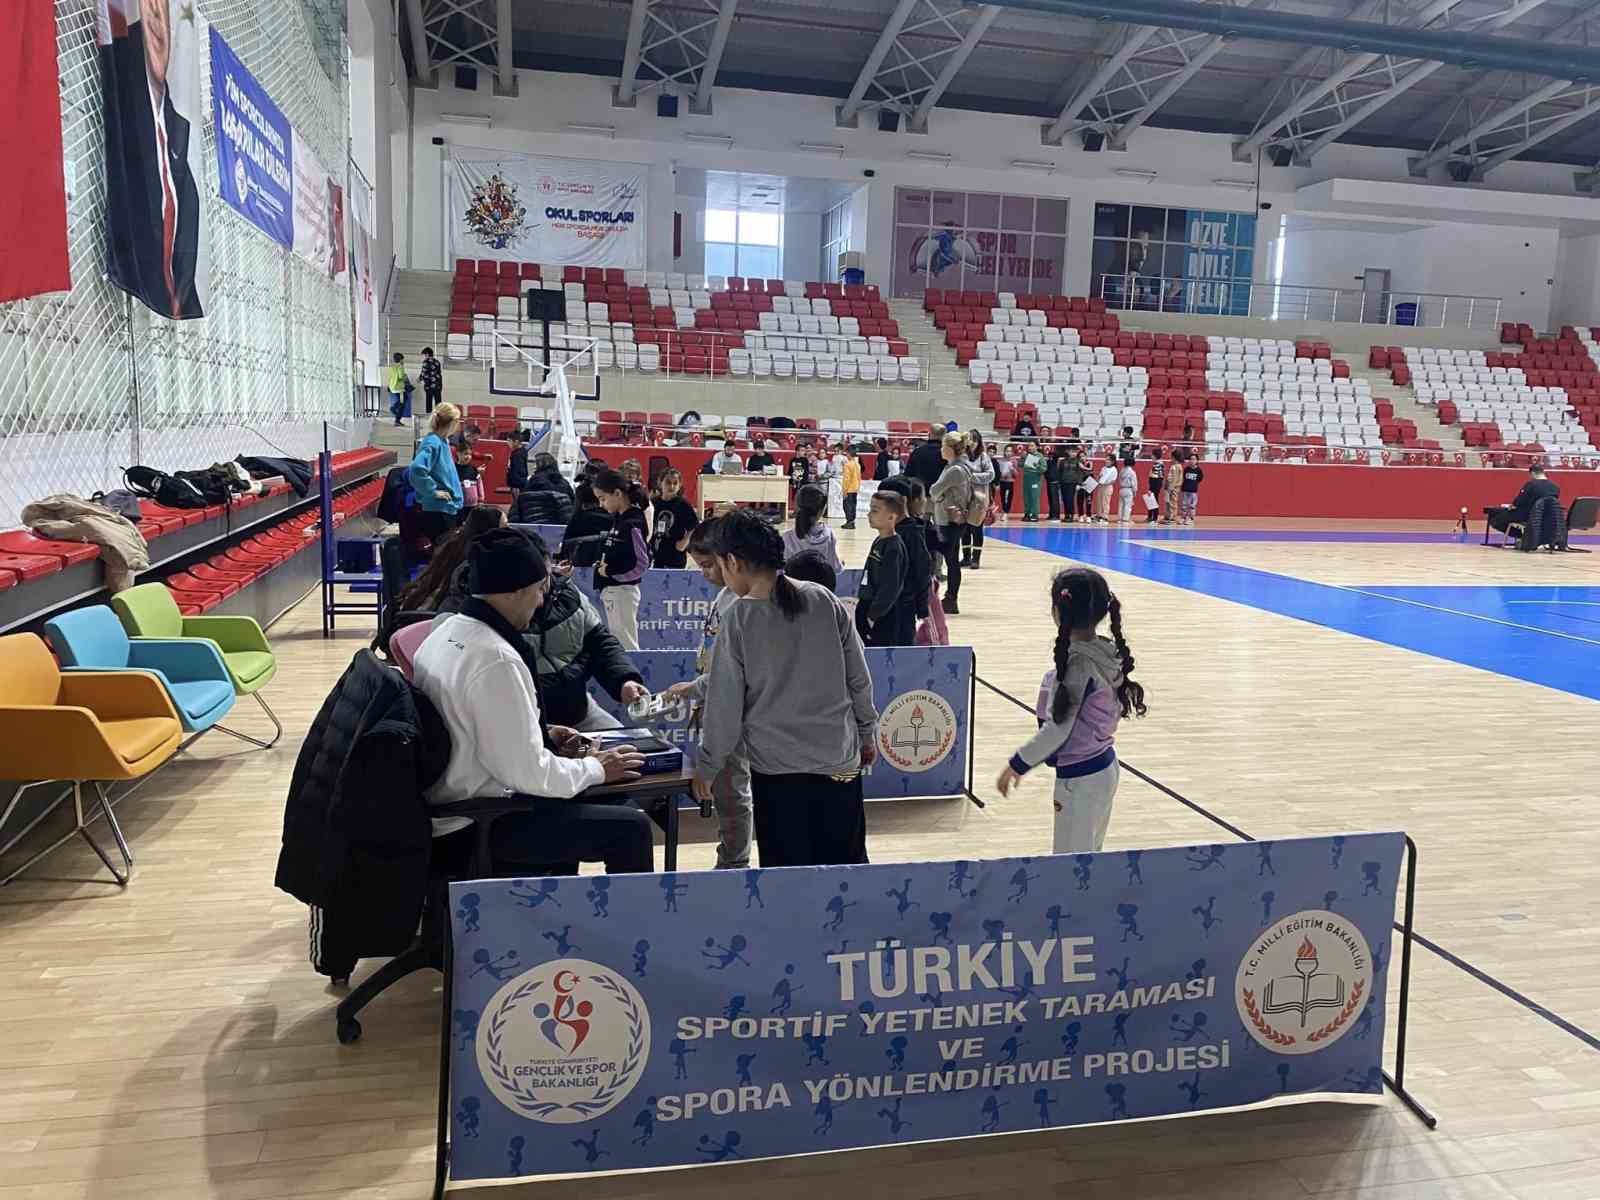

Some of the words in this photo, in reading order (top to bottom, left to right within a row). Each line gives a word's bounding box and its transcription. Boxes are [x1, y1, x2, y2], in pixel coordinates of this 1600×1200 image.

[545, 206, 577, 222] OKUL
[1256, 929, 1285, 956] MİLLİ
[1286, 919, 1323, 935] EĞİTİM
[1325, 922, 1364, 971] BAKANLIĞI
[827, 931, 1096, 1001] TÜRKİYE
[676, 1011, 849, 1040] SPORTİF
[859, 1000, 1029, 1034] YETENEK
[1040, 976, 1216, 1020] TARAMASI
[938, 1036, 985, 1061] VE
[513, 1064, 566, 1077] GENÇLİK
[567, 1063, 584, 1075] VE
[585, 1062, 617, 1075] SPOR
[532, 1075, 599, 1089] BAKANLIĞI
[656, 1082, 792, 1122] SPORA
[803, 1056, 1072, 1105] YÖNLENDİRME
[1083, 1040, 1230, 1078] PROJESİ
